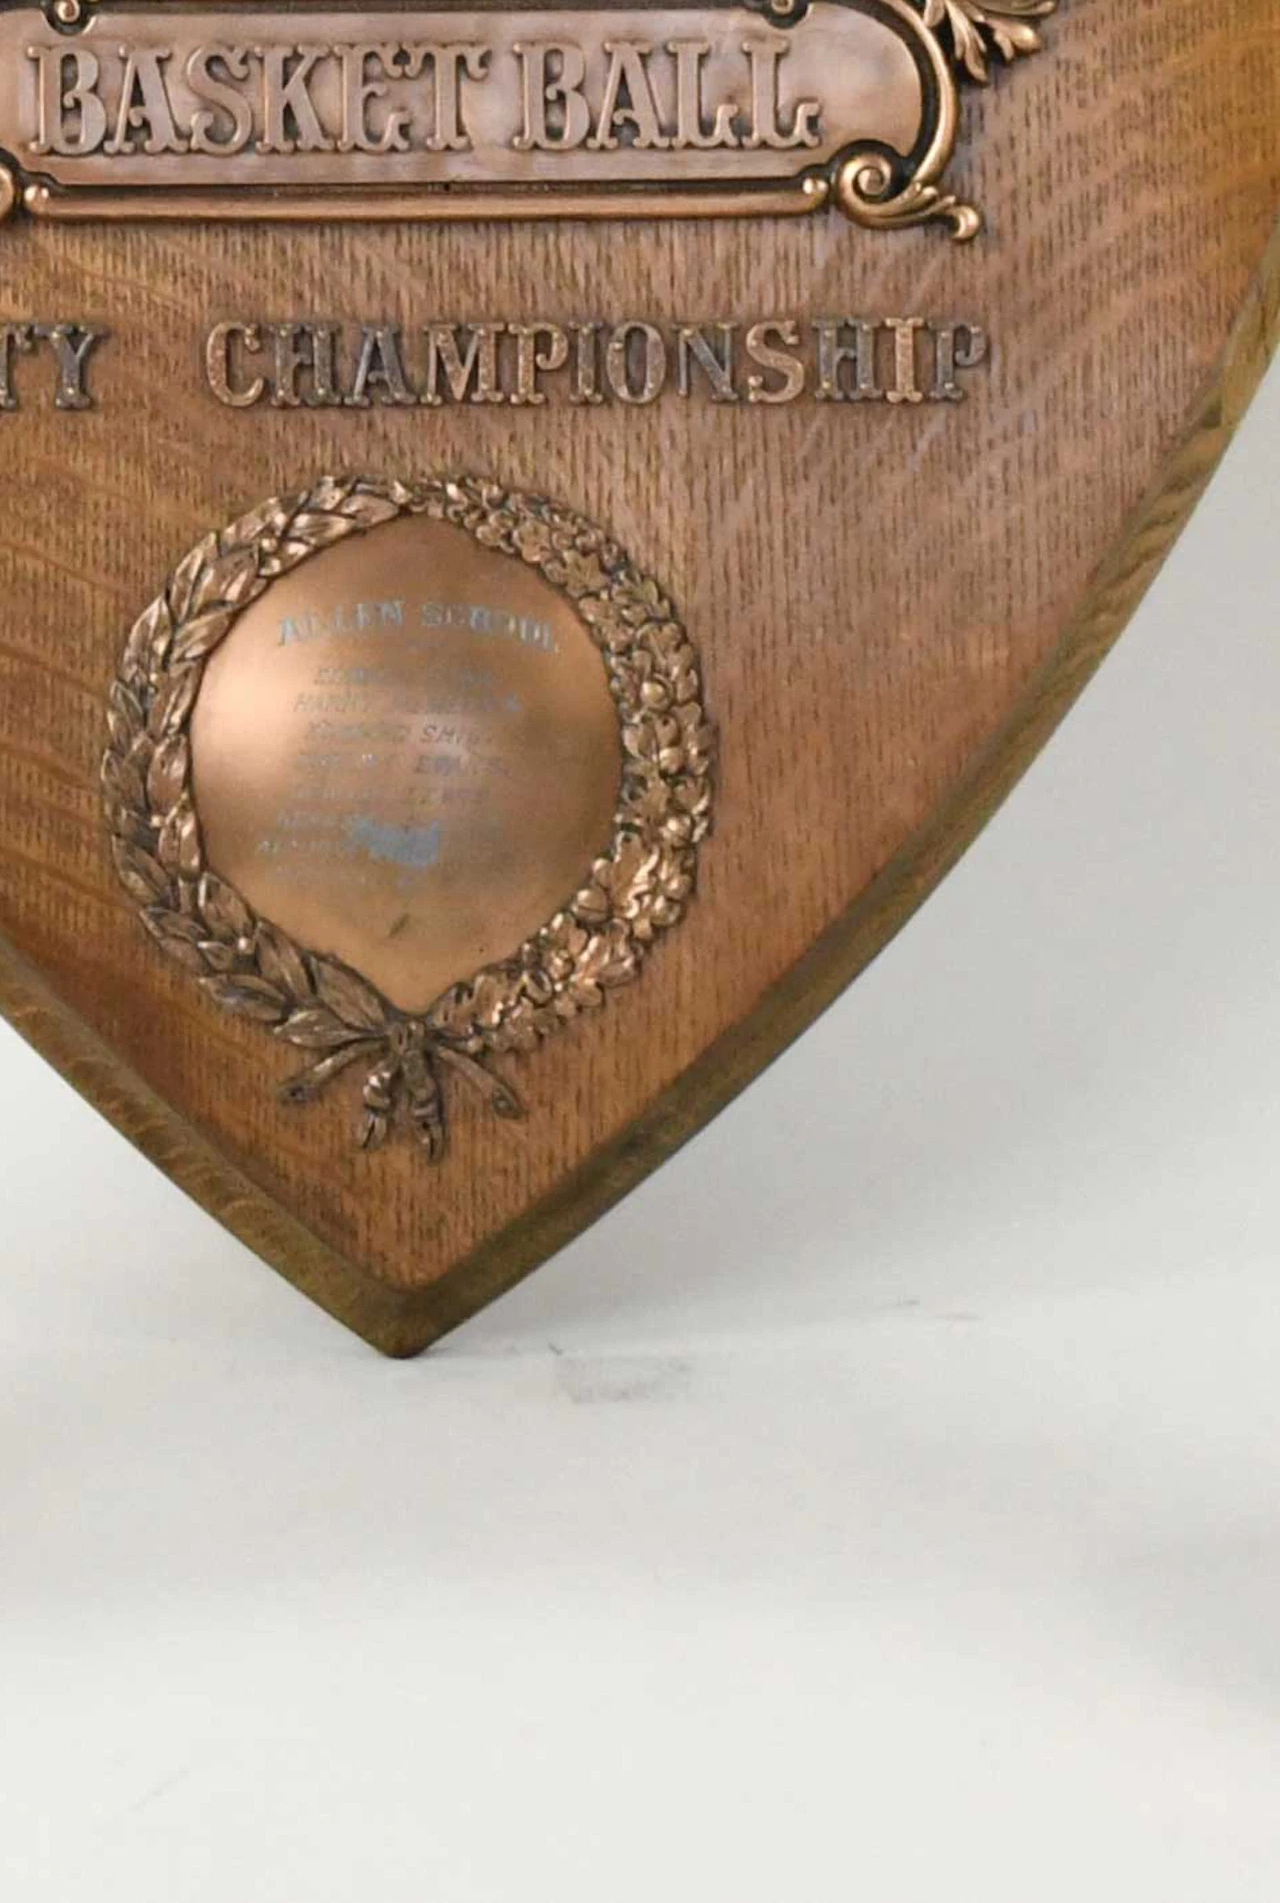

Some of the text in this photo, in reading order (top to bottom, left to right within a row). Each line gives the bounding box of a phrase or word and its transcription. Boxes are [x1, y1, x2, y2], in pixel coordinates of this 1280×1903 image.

[25, 35, 822, 158] BASKET BALL
[204, 317, 989, 411] CHAMPIONSHIP
